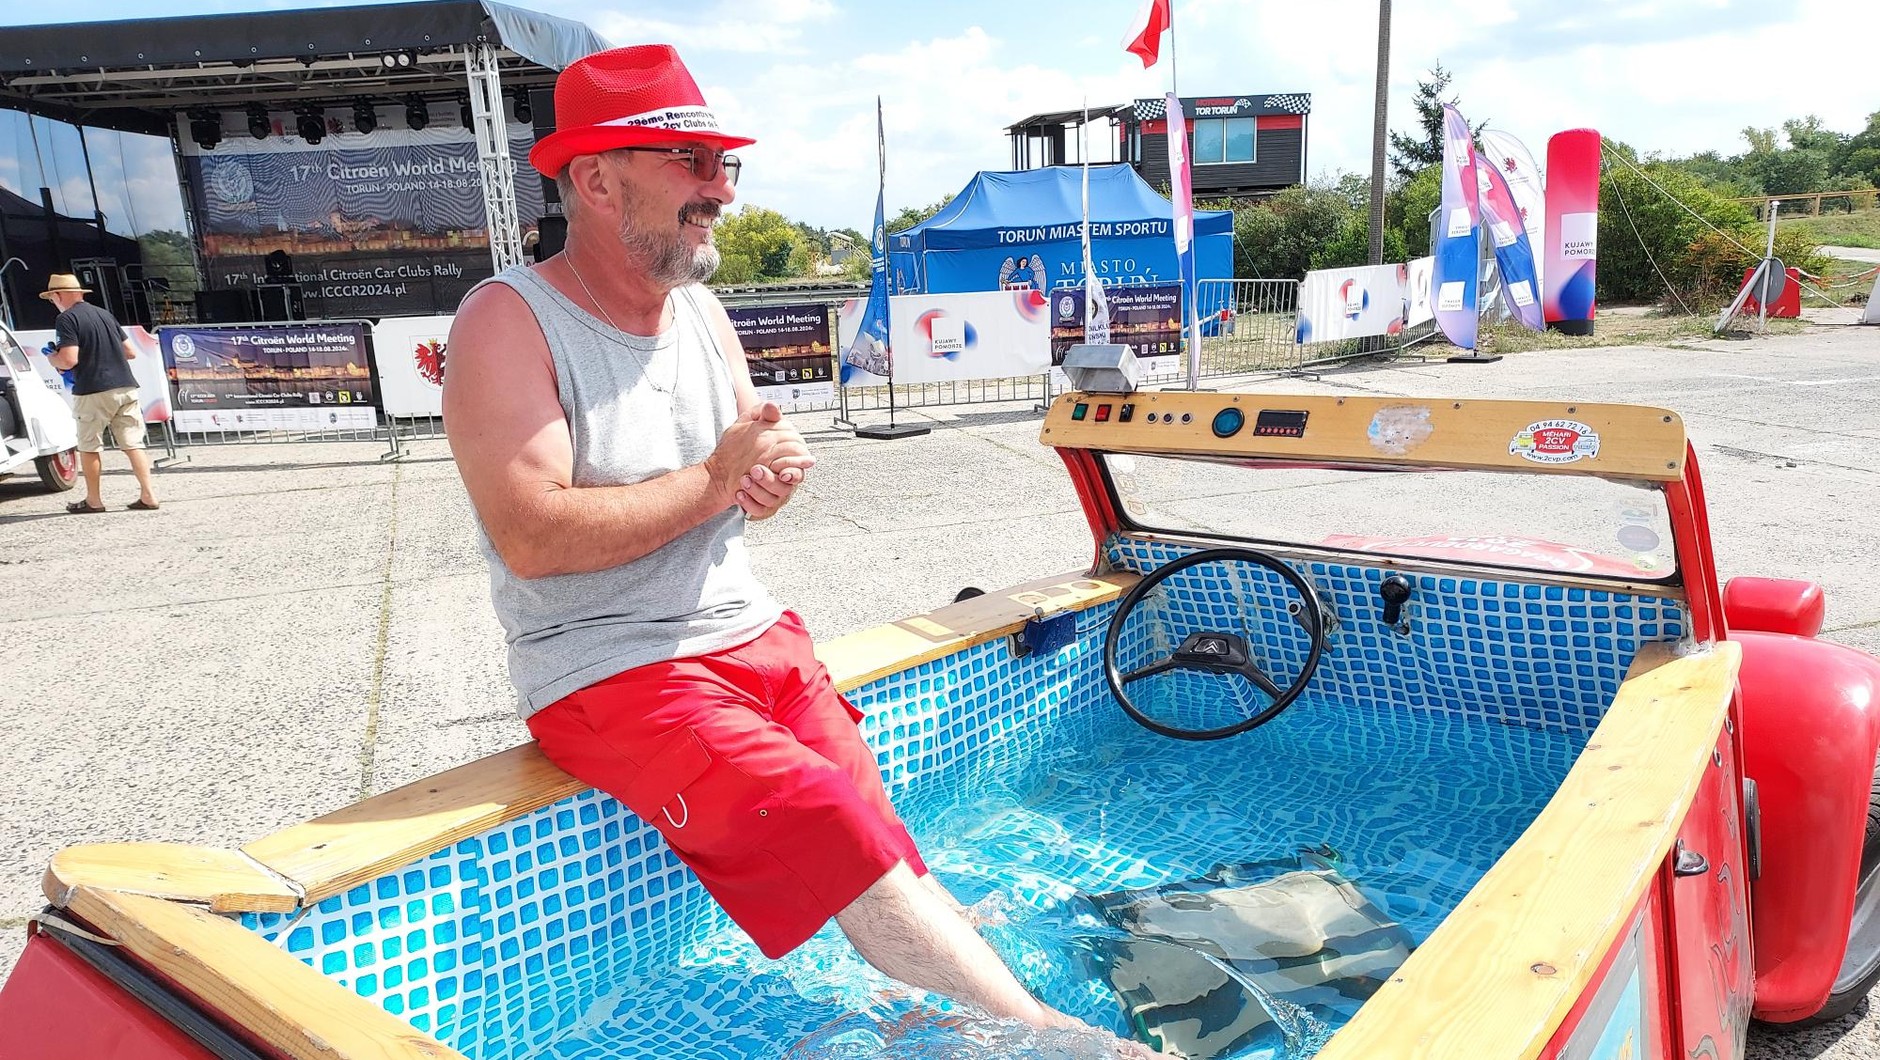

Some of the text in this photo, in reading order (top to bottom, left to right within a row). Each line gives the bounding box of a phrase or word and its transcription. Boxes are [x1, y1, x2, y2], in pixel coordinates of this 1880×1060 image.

[1195, 106, 1211, 115] TOR
[683, 119, 706, 128] Clubs
[290, 156, 518, 182] 17th Citroën World Meeg
[346, 183, 380, 194] TORUN
[387, 181, 426, 193] POLAND
[427, 178, 482, 189] 14-18.08.20
[997, 225, 1046, 243] TORUŃ
[1115, 221, 1167, 236] SPORTU
[224, 263, 463, 285] 17th Intional Citroën Car Clubs Rally
[303, 283, 407, 298] w.ICCCR2024.pl
[1112, 295, 1133, 303] Citroën
[1134, 293, 1152, 303] World
[1153, 293, 1177, 303] Meeting
[731, 313, 821, 328] itroën World Meeting
[231, 333, 356, 346] 17th Citroën World Meeting
[1529, 423, 1541, 432] 04
[1567, 422, 1578, 430] 72
[1579, 426, 1588, 435] 16
[1545, 437, 1566, 445] 2CV
